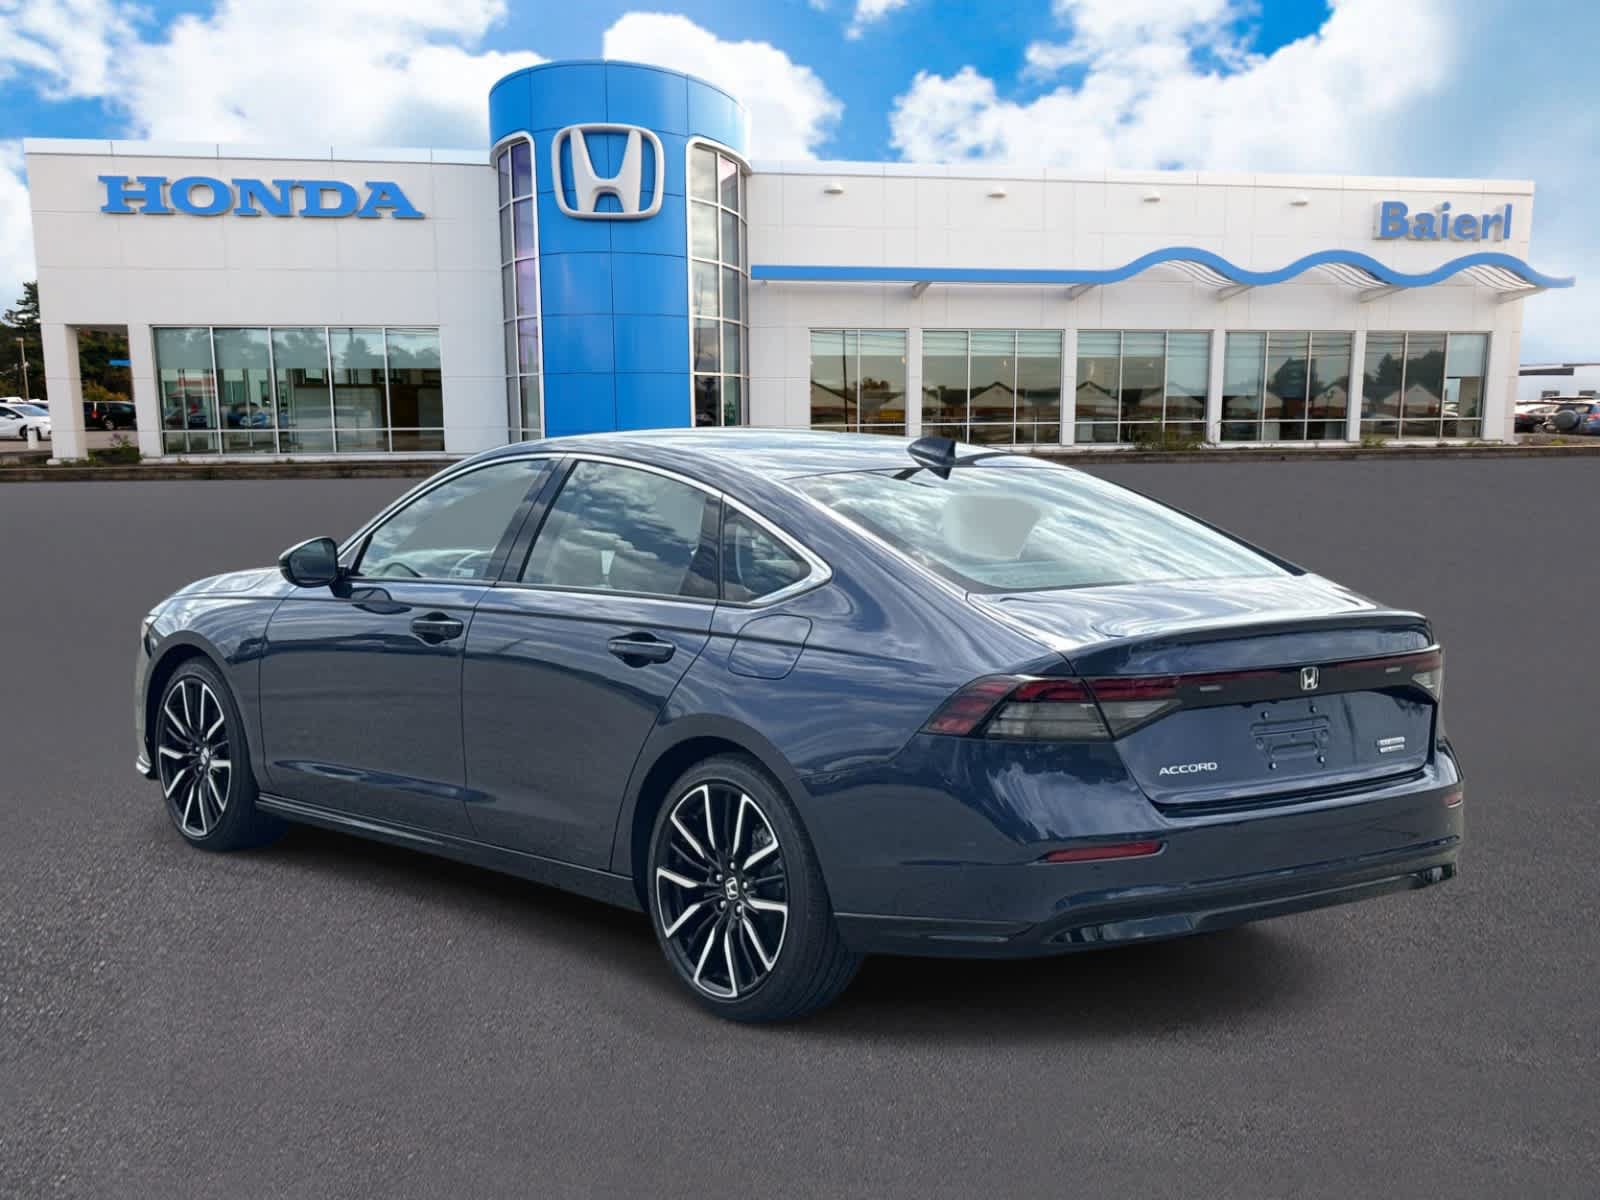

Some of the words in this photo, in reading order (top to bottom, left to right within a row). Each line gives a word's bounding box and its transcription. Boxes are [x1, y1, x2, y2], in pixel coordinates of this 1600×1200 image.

[97, 175, 426, 218] HONDA
[1379, 200, 1513, 240] Baierl
[1159, 762, 1218, 776] ACCORD
